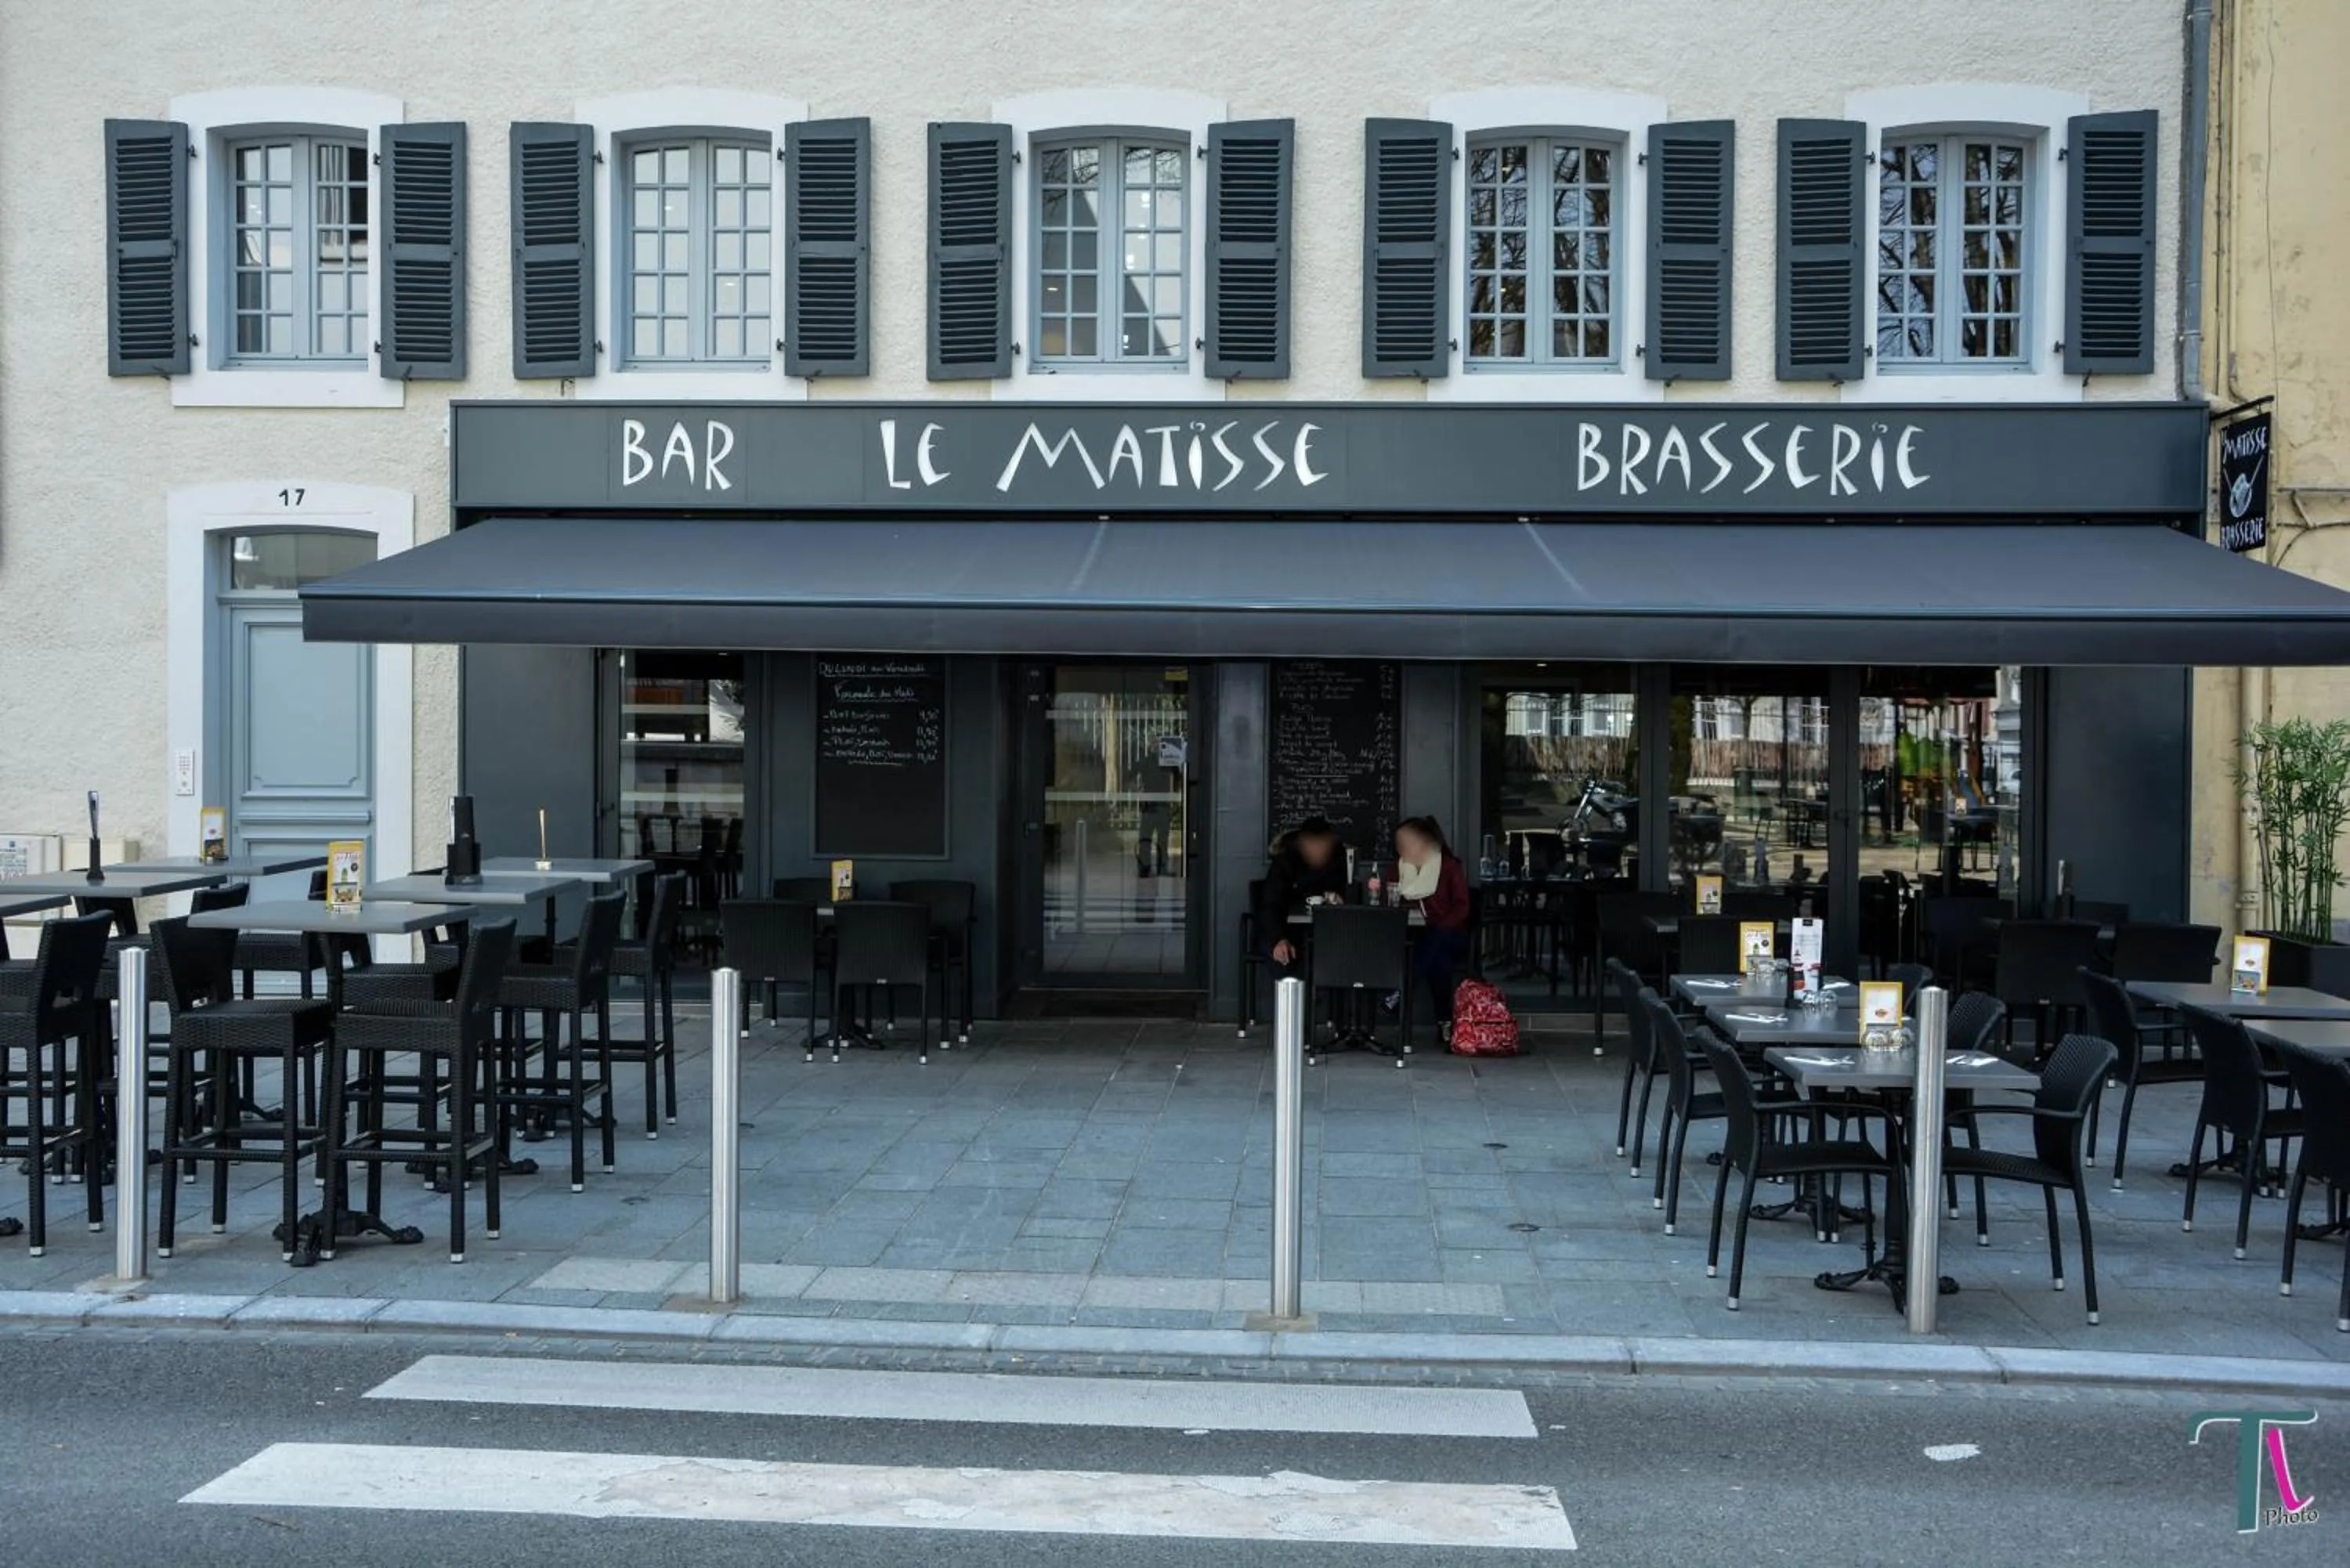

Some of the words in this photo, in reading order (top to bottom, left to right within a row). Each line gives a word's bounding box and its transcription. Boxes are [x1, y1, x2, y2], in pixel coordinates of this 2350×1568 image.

[623, 419, 735, 490] BAR
[880, 420, 952, 490] LE
[278, 488, 306, 507] 17
